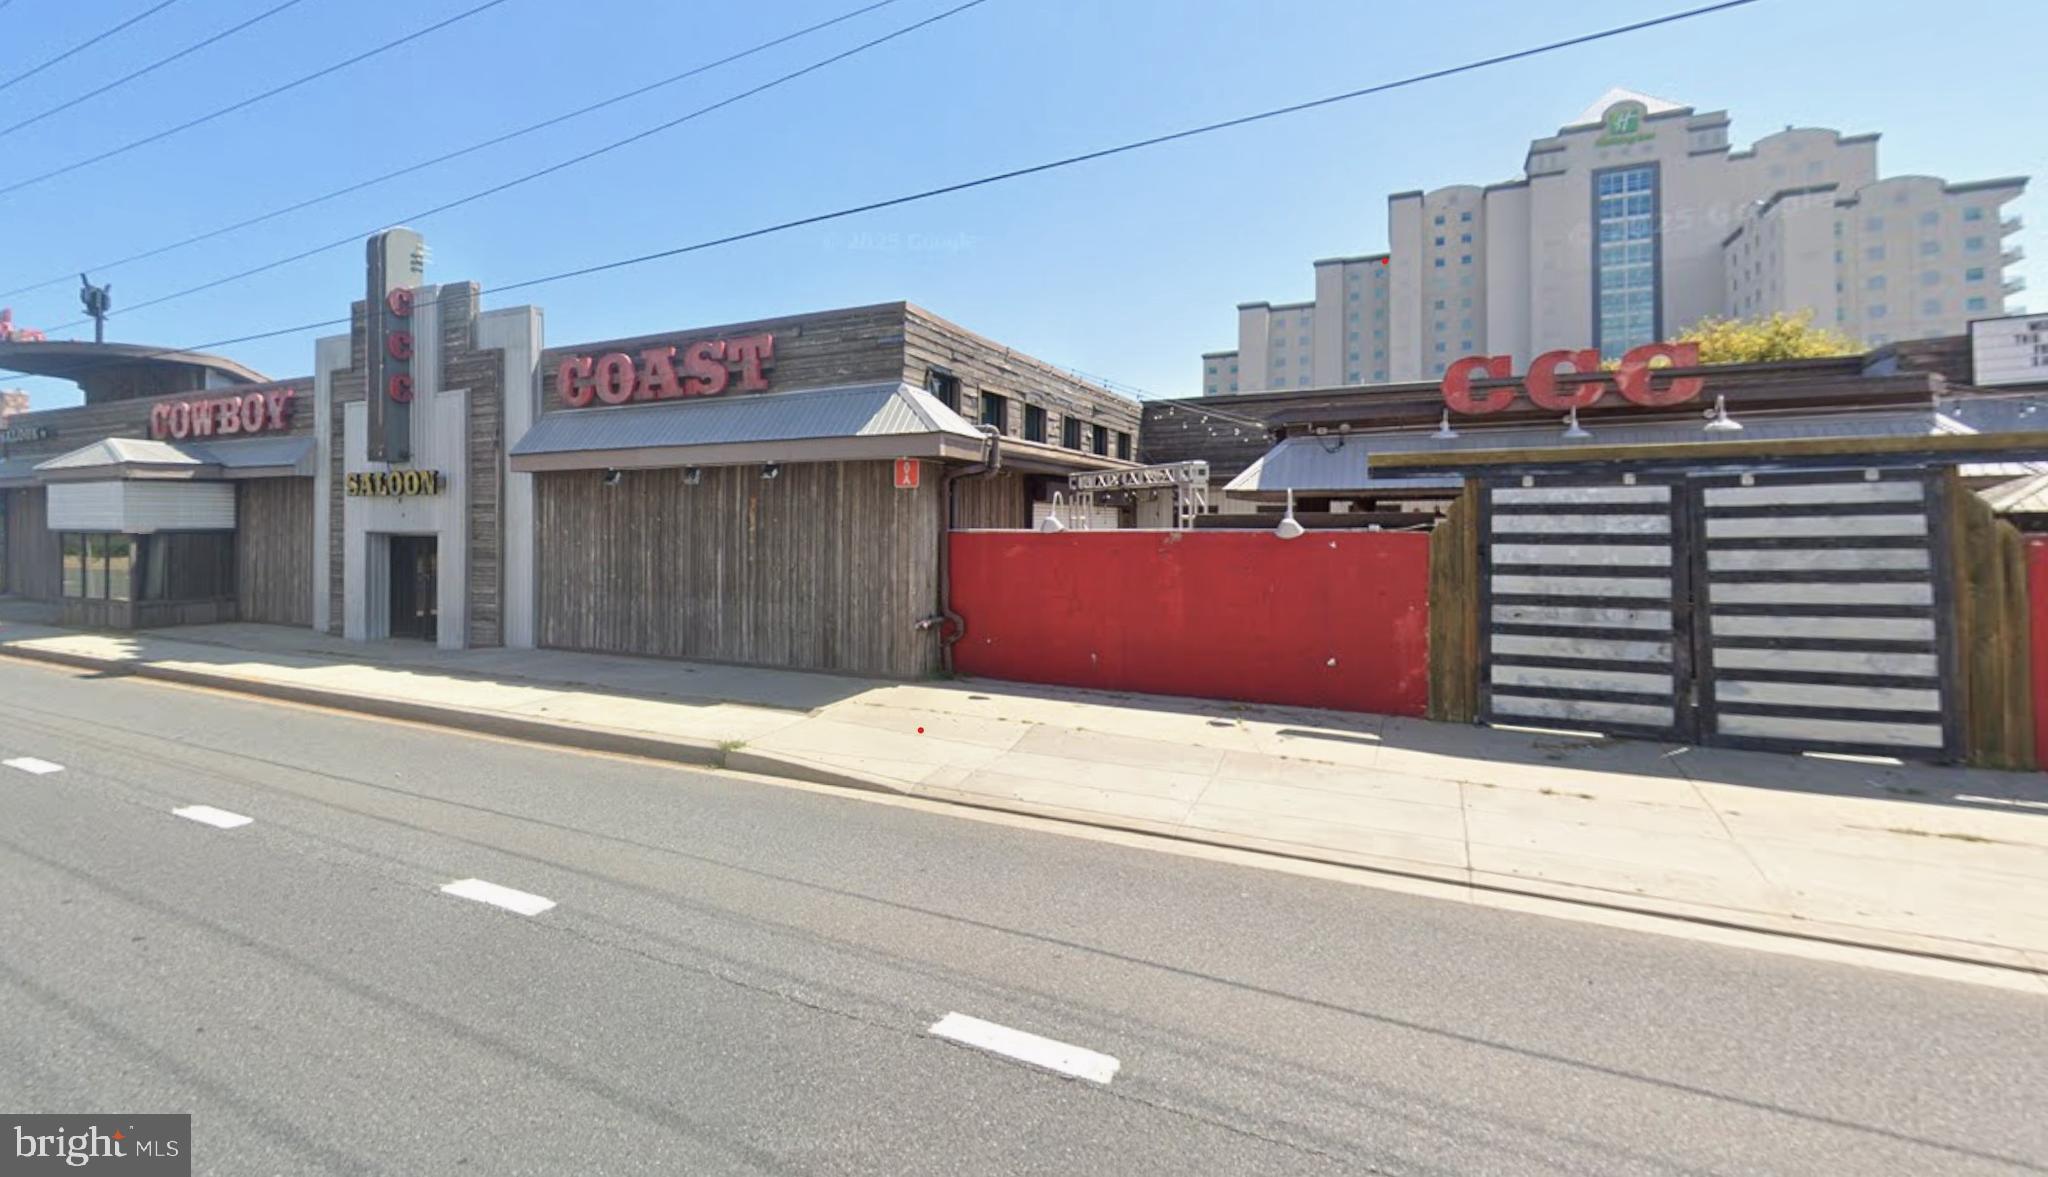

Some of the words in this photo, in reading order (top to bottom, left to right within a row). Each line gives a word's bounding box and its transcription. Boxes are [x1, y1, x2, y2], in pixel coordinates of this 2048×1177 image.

[556, 333, 774, 407] COAST
[150, 386, 295, 440] COWBOY
[346, 469, 440, 496] SALOON
